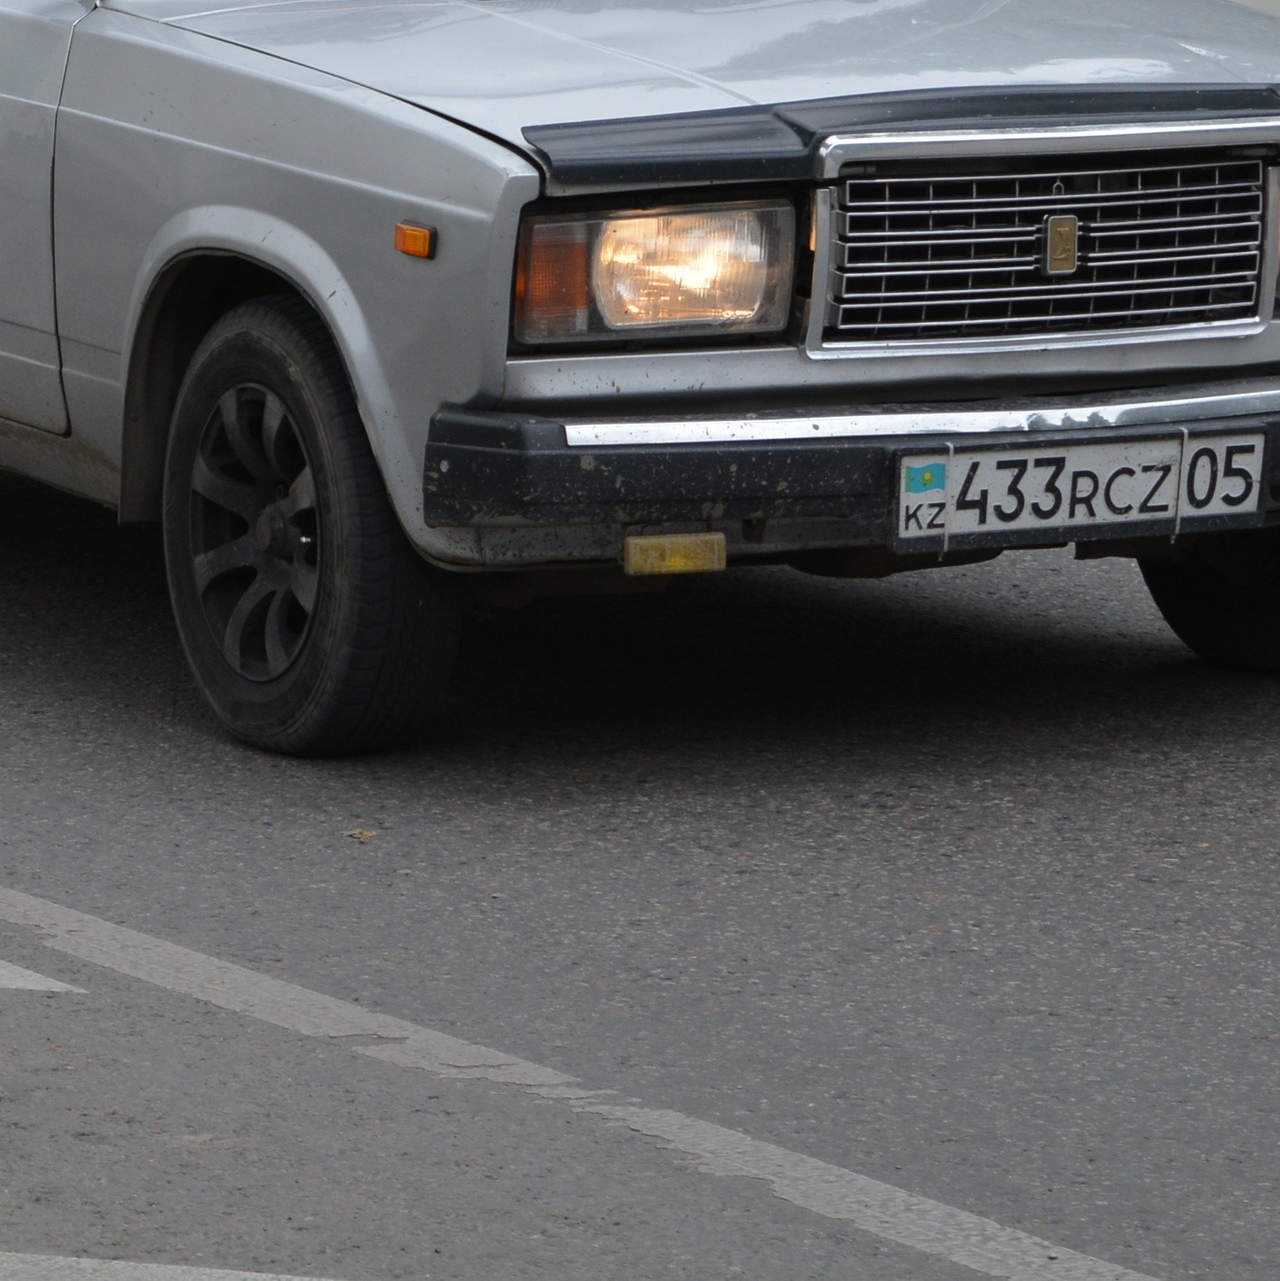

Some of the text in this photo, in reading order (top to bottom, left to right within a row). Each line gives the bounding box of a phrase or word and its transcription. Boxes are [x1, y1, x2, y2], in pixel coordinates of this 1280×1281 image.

[955, 443, 1256, 526] 433RCZ 05
[904, 501, 946, 531] KZ
